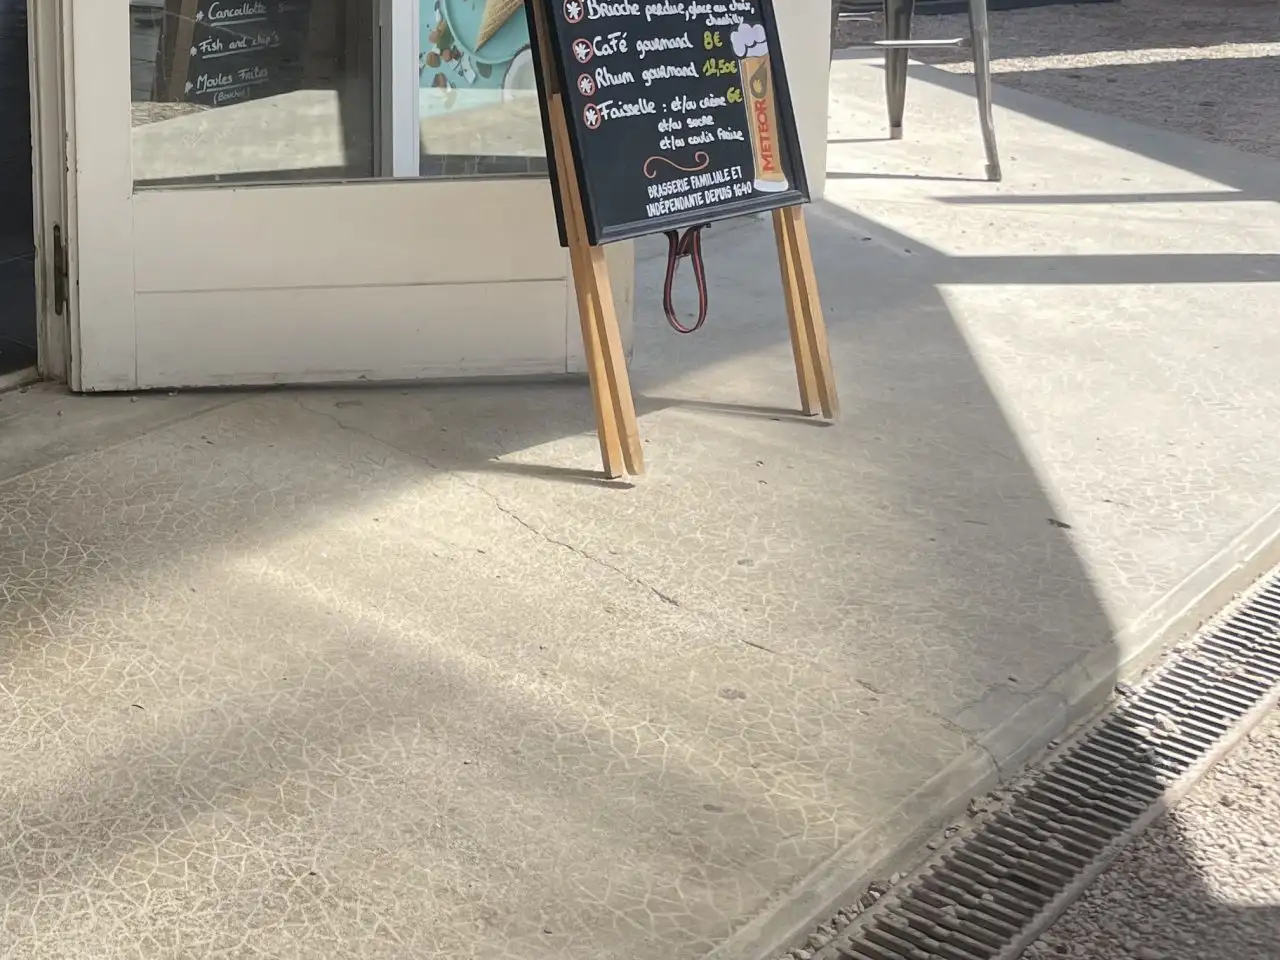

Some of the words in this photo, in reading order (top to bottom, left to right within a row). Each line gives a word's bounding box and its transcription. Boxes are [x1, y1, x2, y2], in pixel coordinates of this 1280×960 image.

[199, 36, 223, 53] Fish
[229, 37, 247, 49] and
[703, 31, 723, 50] 8€
[595, 62, 635, 89] Rhum
[726, 86, 743, 104] 6€
[754, 98, 776, 172] METEOR
[647, 174, 689, 199] BRASSERIE
[690, 169, 729, 189] FAMILIALE
[730, 165, 743, 180] ET
[645, 190, 704, 218] INDÉPENDANTE
[704, 185, 733, 204] DEPUIS
[733, 181, 753, 198] 1640
